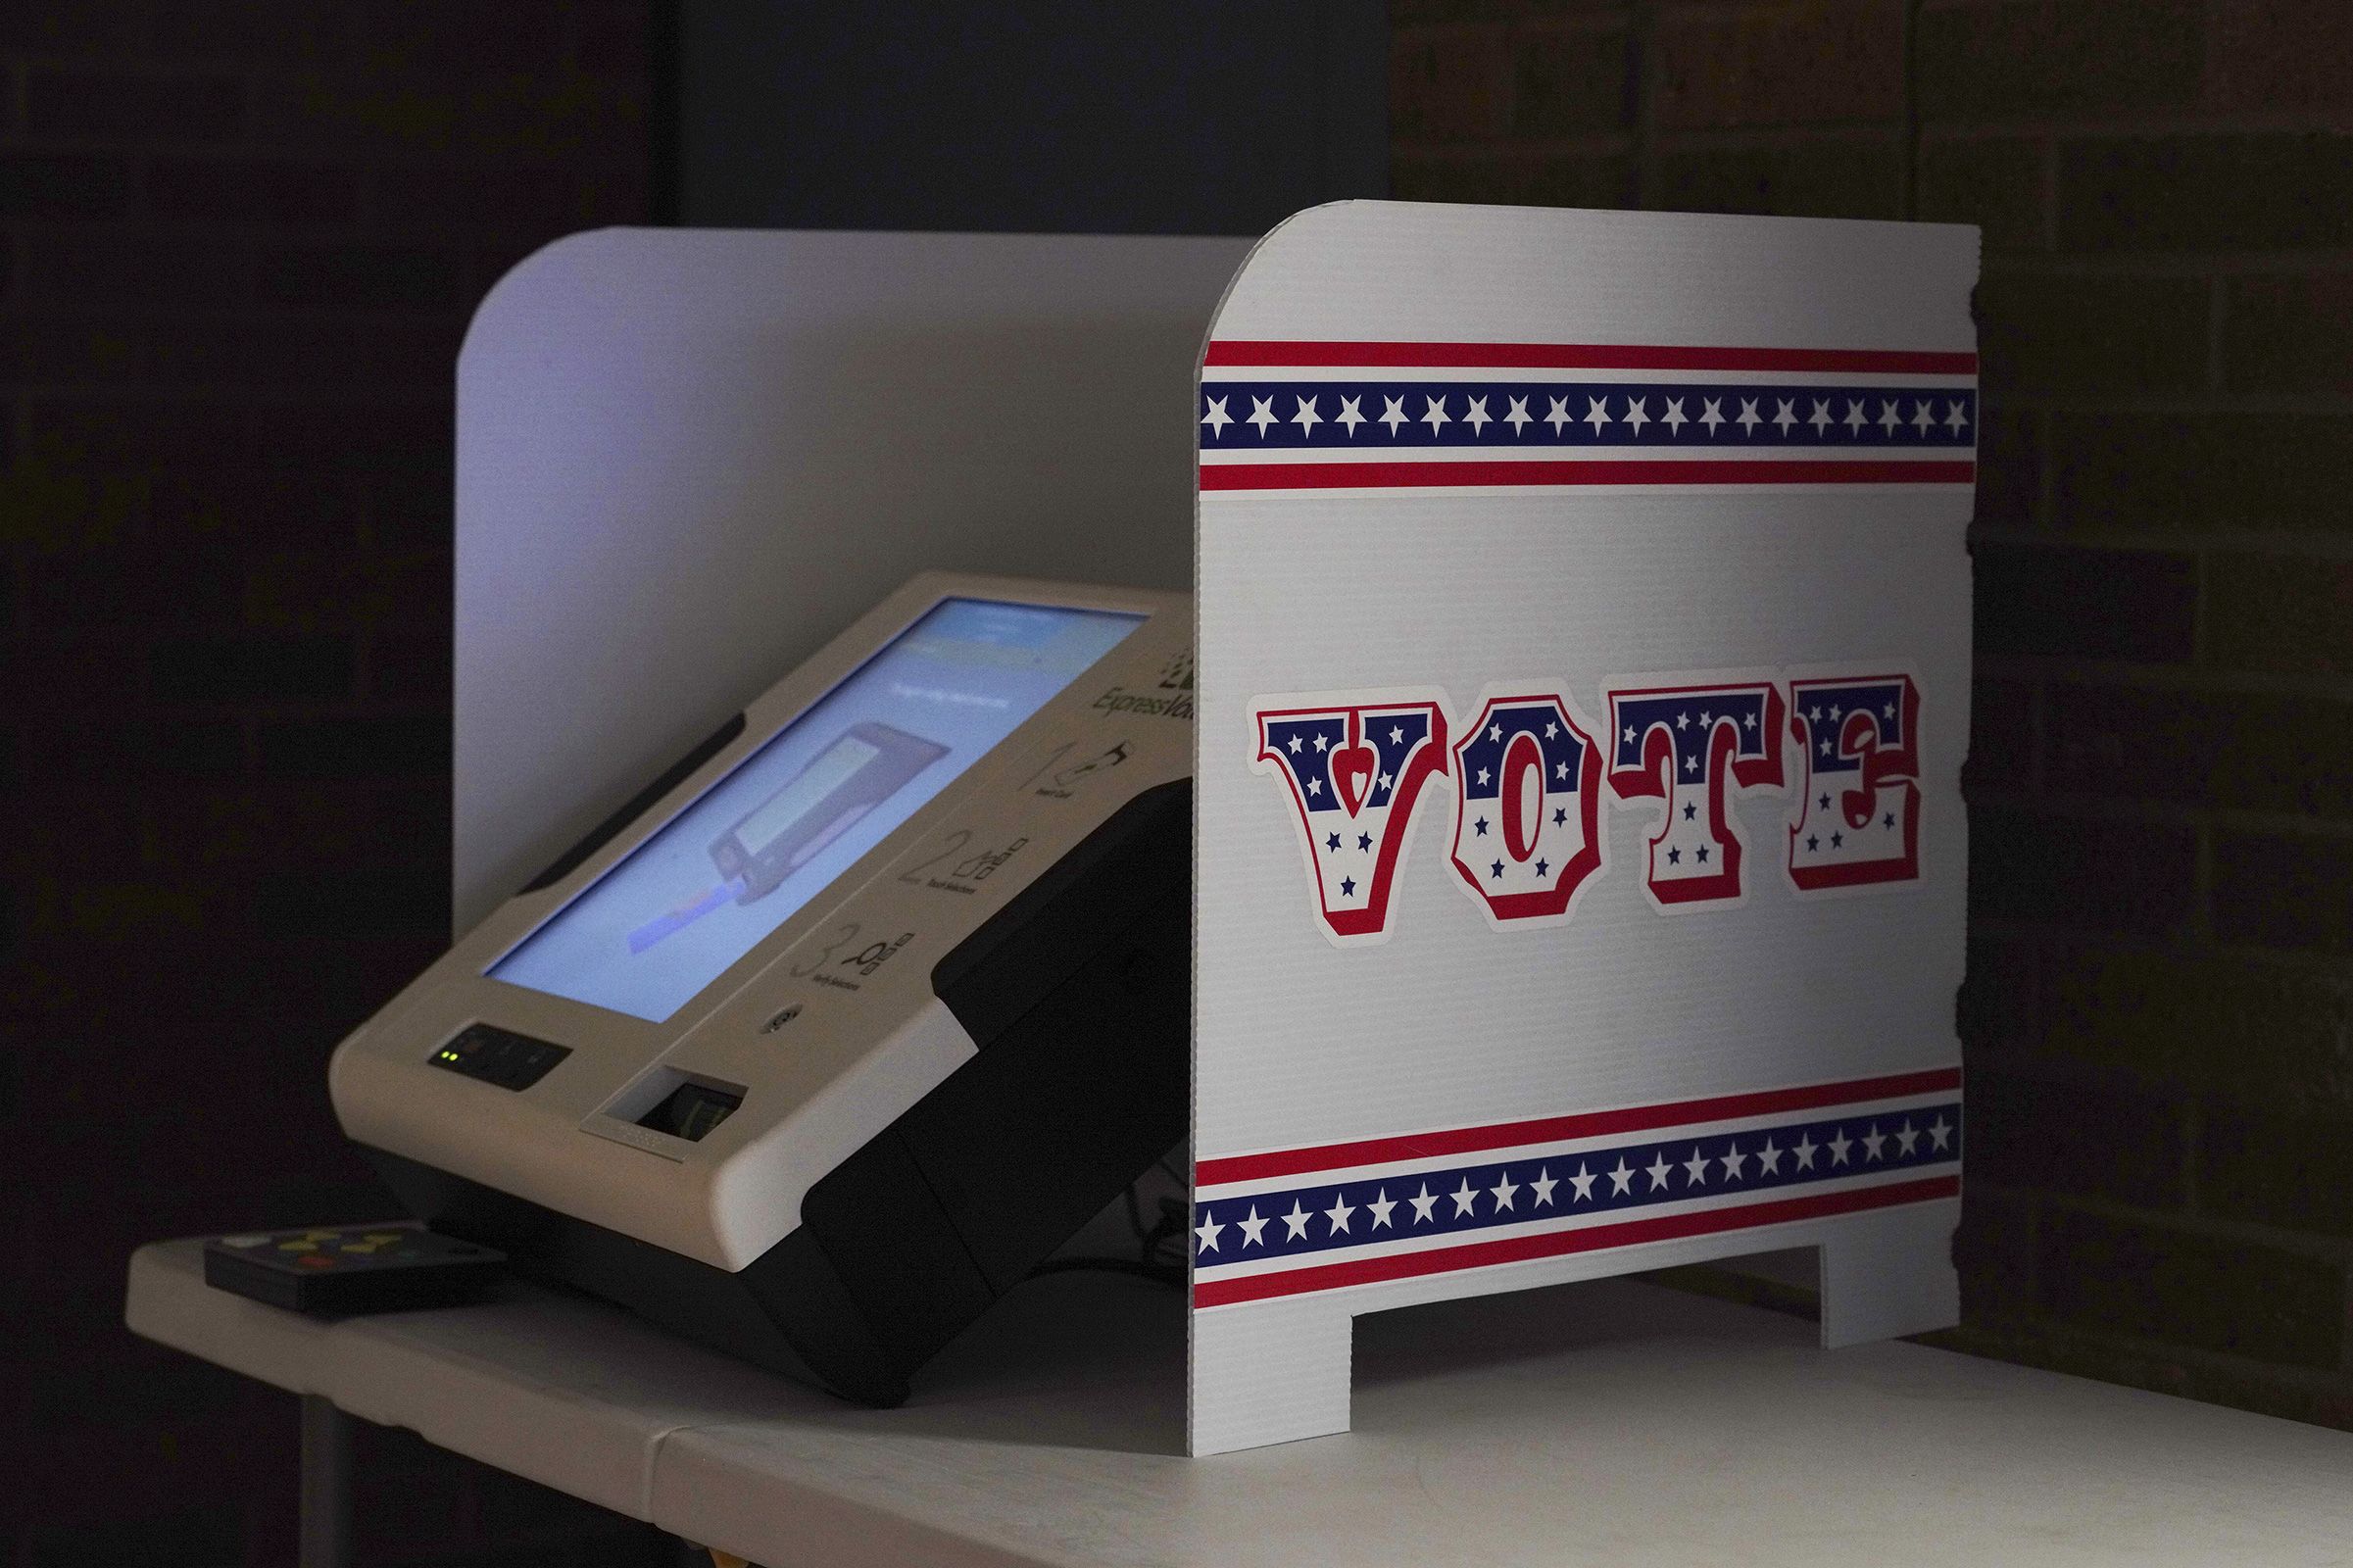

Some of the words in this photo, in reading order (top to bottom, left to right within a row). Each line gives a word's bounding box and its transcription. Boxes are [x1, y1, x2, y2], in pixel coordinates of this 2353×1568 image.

[1255, 673, 1920, 936] VOTE
[899, 829, 973, 885] 2
[790, 923, 860, 978] 3
